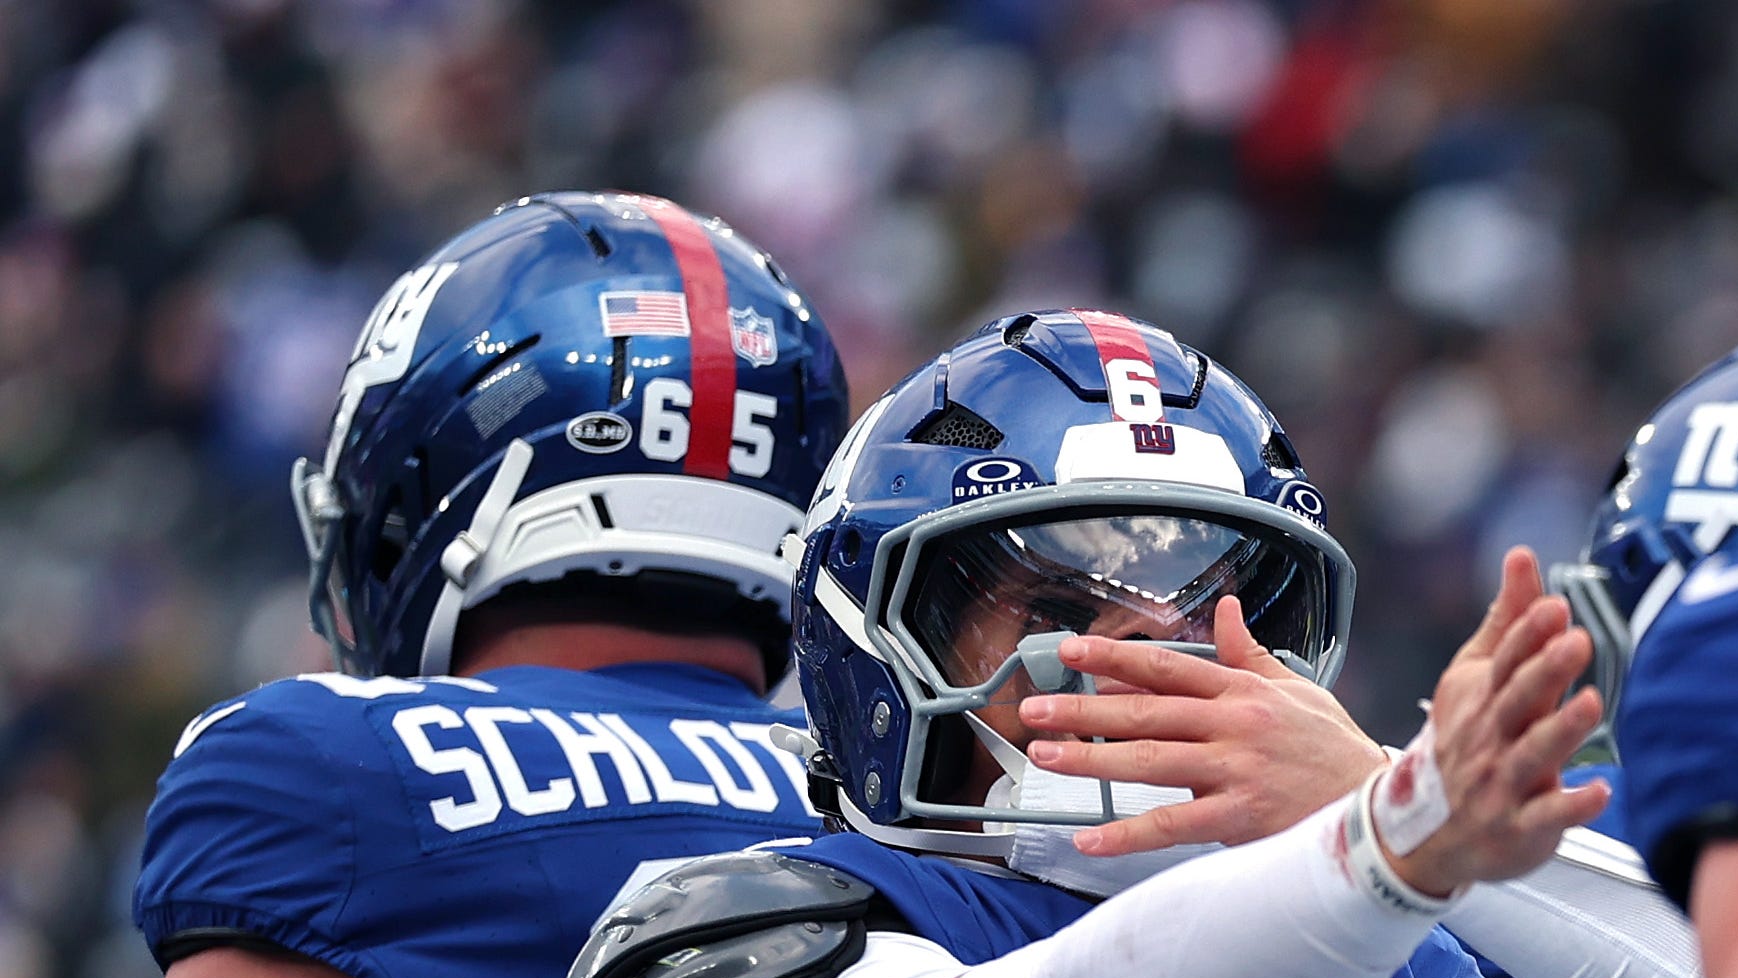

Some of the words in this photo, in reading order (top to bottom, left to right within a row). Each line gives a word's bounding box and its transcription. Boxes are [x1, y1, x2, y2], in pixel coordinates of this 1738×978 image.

[1105, 358, 1164, 422] 6
[639, 380, 778, 478] 65
[954, 481, 1034, 497] OAKLEY
